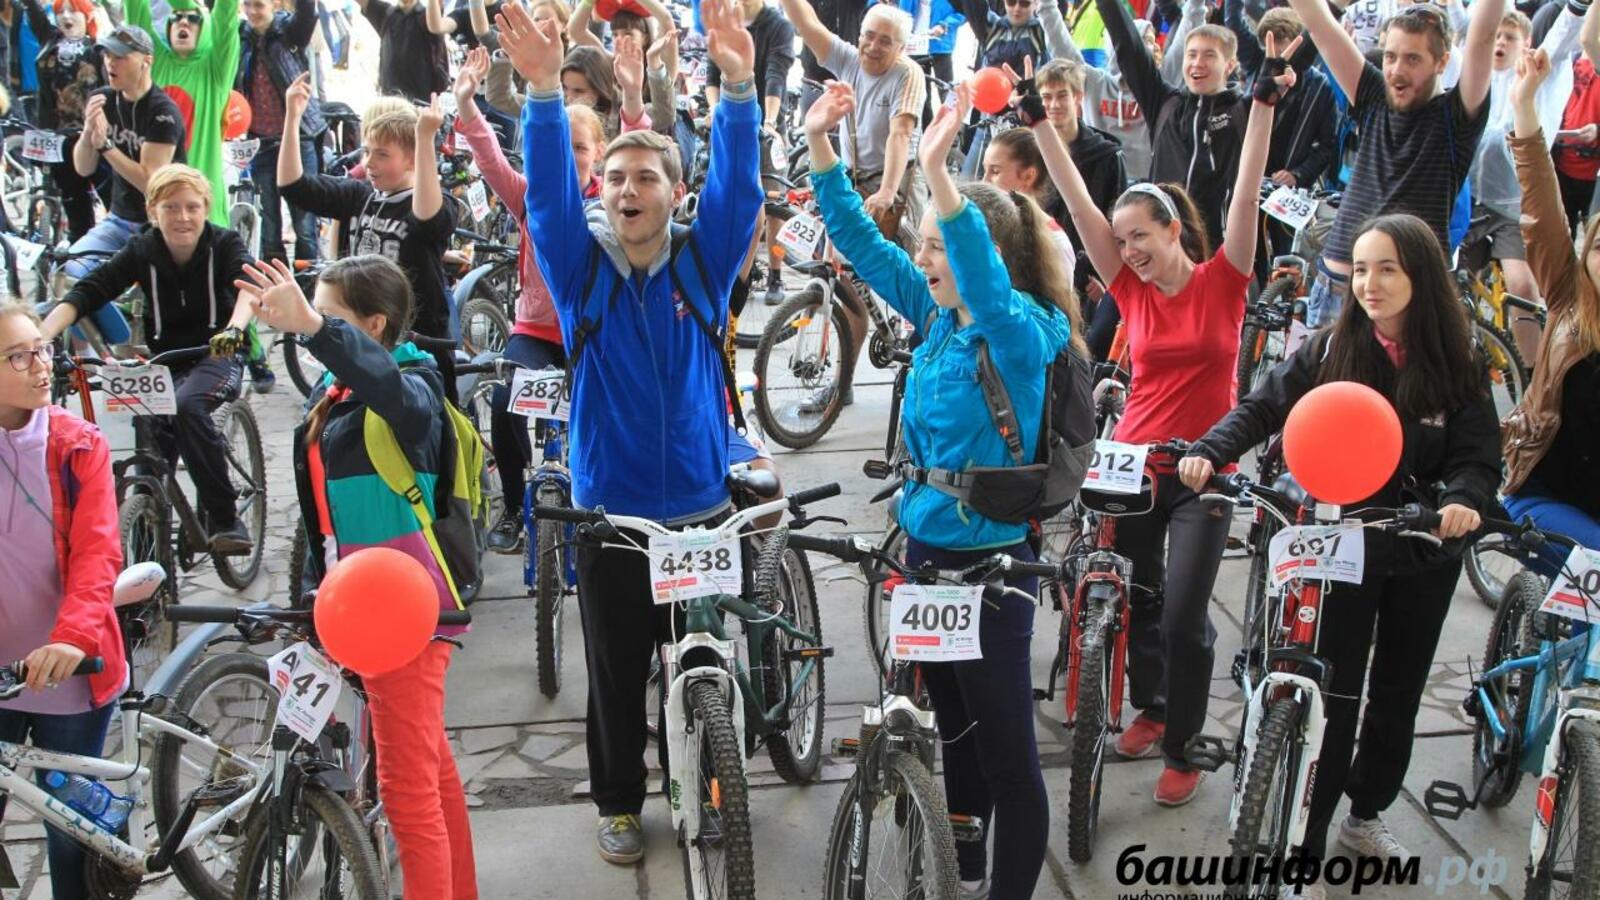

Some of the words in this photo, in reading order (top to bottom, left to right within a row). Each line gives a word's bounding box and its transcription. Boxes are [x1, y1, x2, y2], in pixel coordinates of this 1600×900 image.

[110, 374, 167, 395] 6286
[660, 547, 732, 576] 4438
[901, 603, 972, 632] 4003
